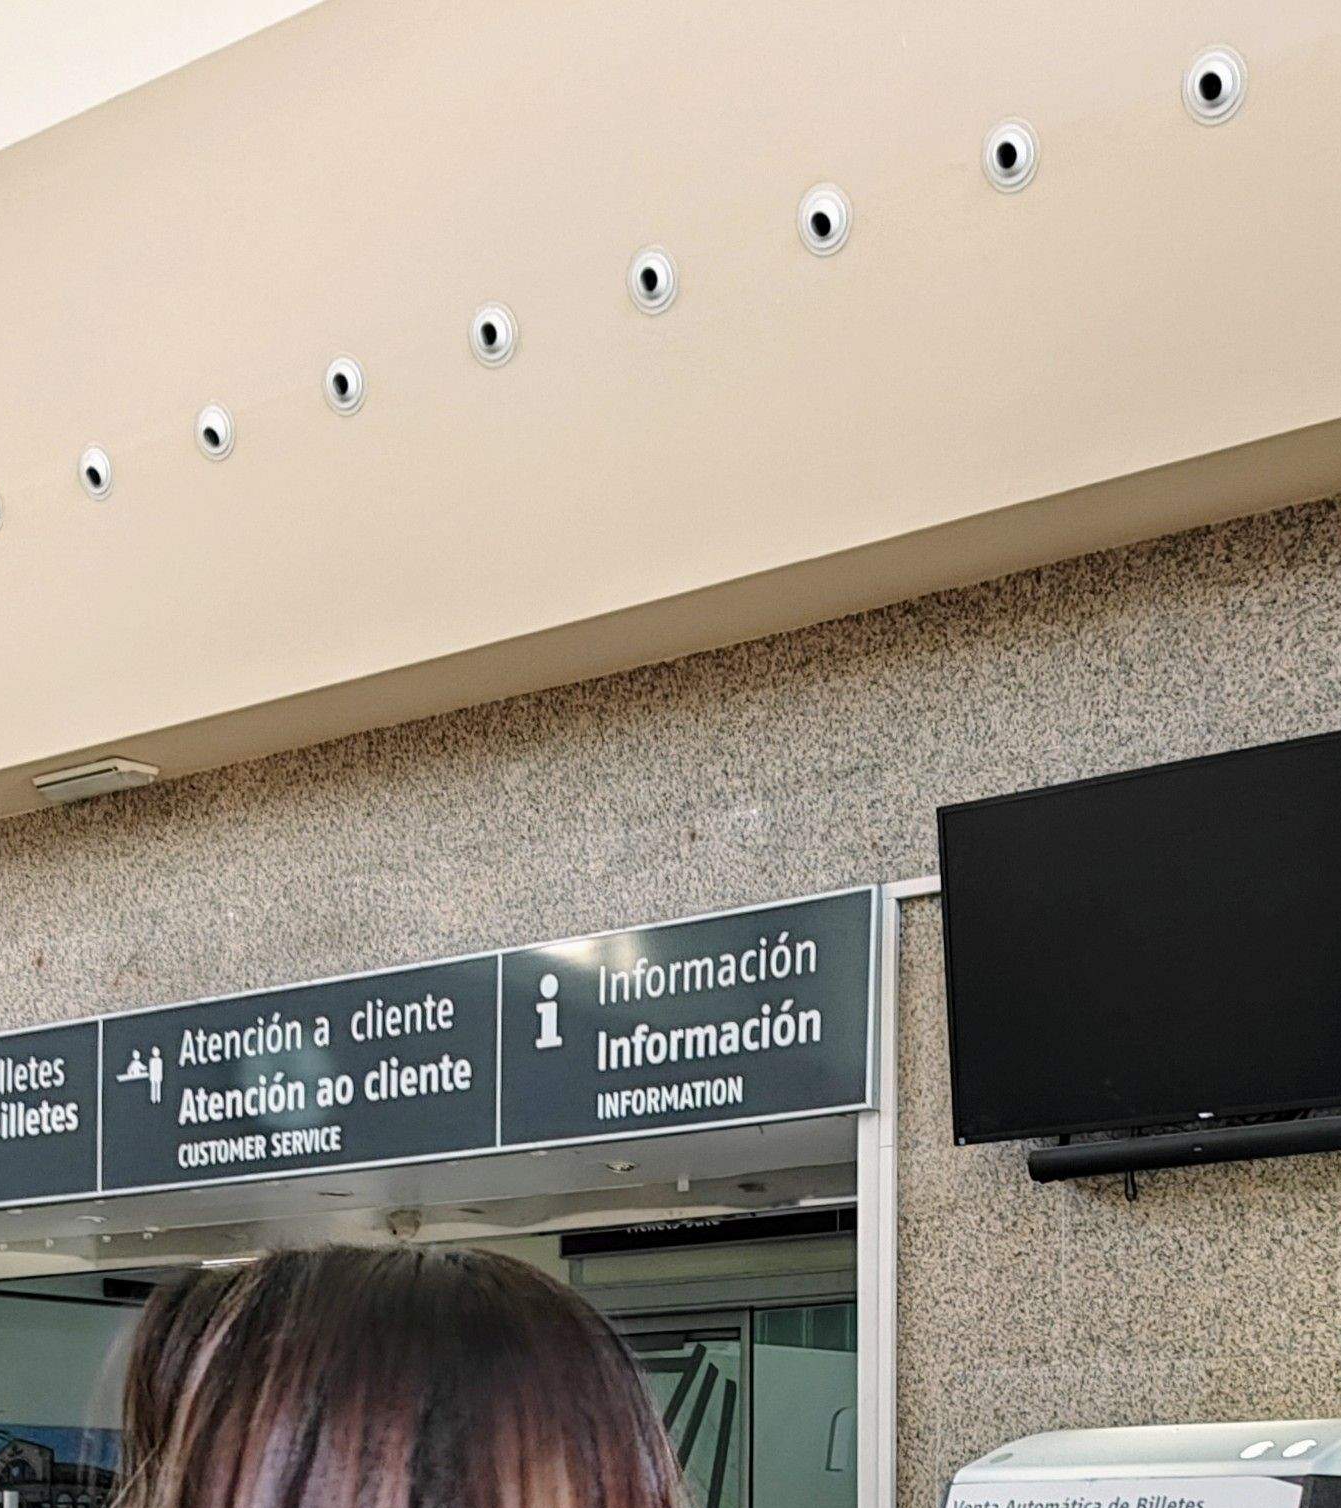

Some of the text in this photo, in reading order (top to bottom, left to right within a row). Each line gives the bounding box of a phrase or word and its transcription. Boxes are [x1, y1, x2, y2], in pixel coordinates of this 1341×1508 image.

[599, 931, 817, 1005] Información
[178, 994, 454, 1067] Atención a cliente
[597, 999, 821, 1072] Información
[178, 1054, 473, 1126] Atención ao cliente
[597, 1075, 744, 1120] INFORMATION
[178, 1125, 342, 1169] CUSTOMER SERVICE
